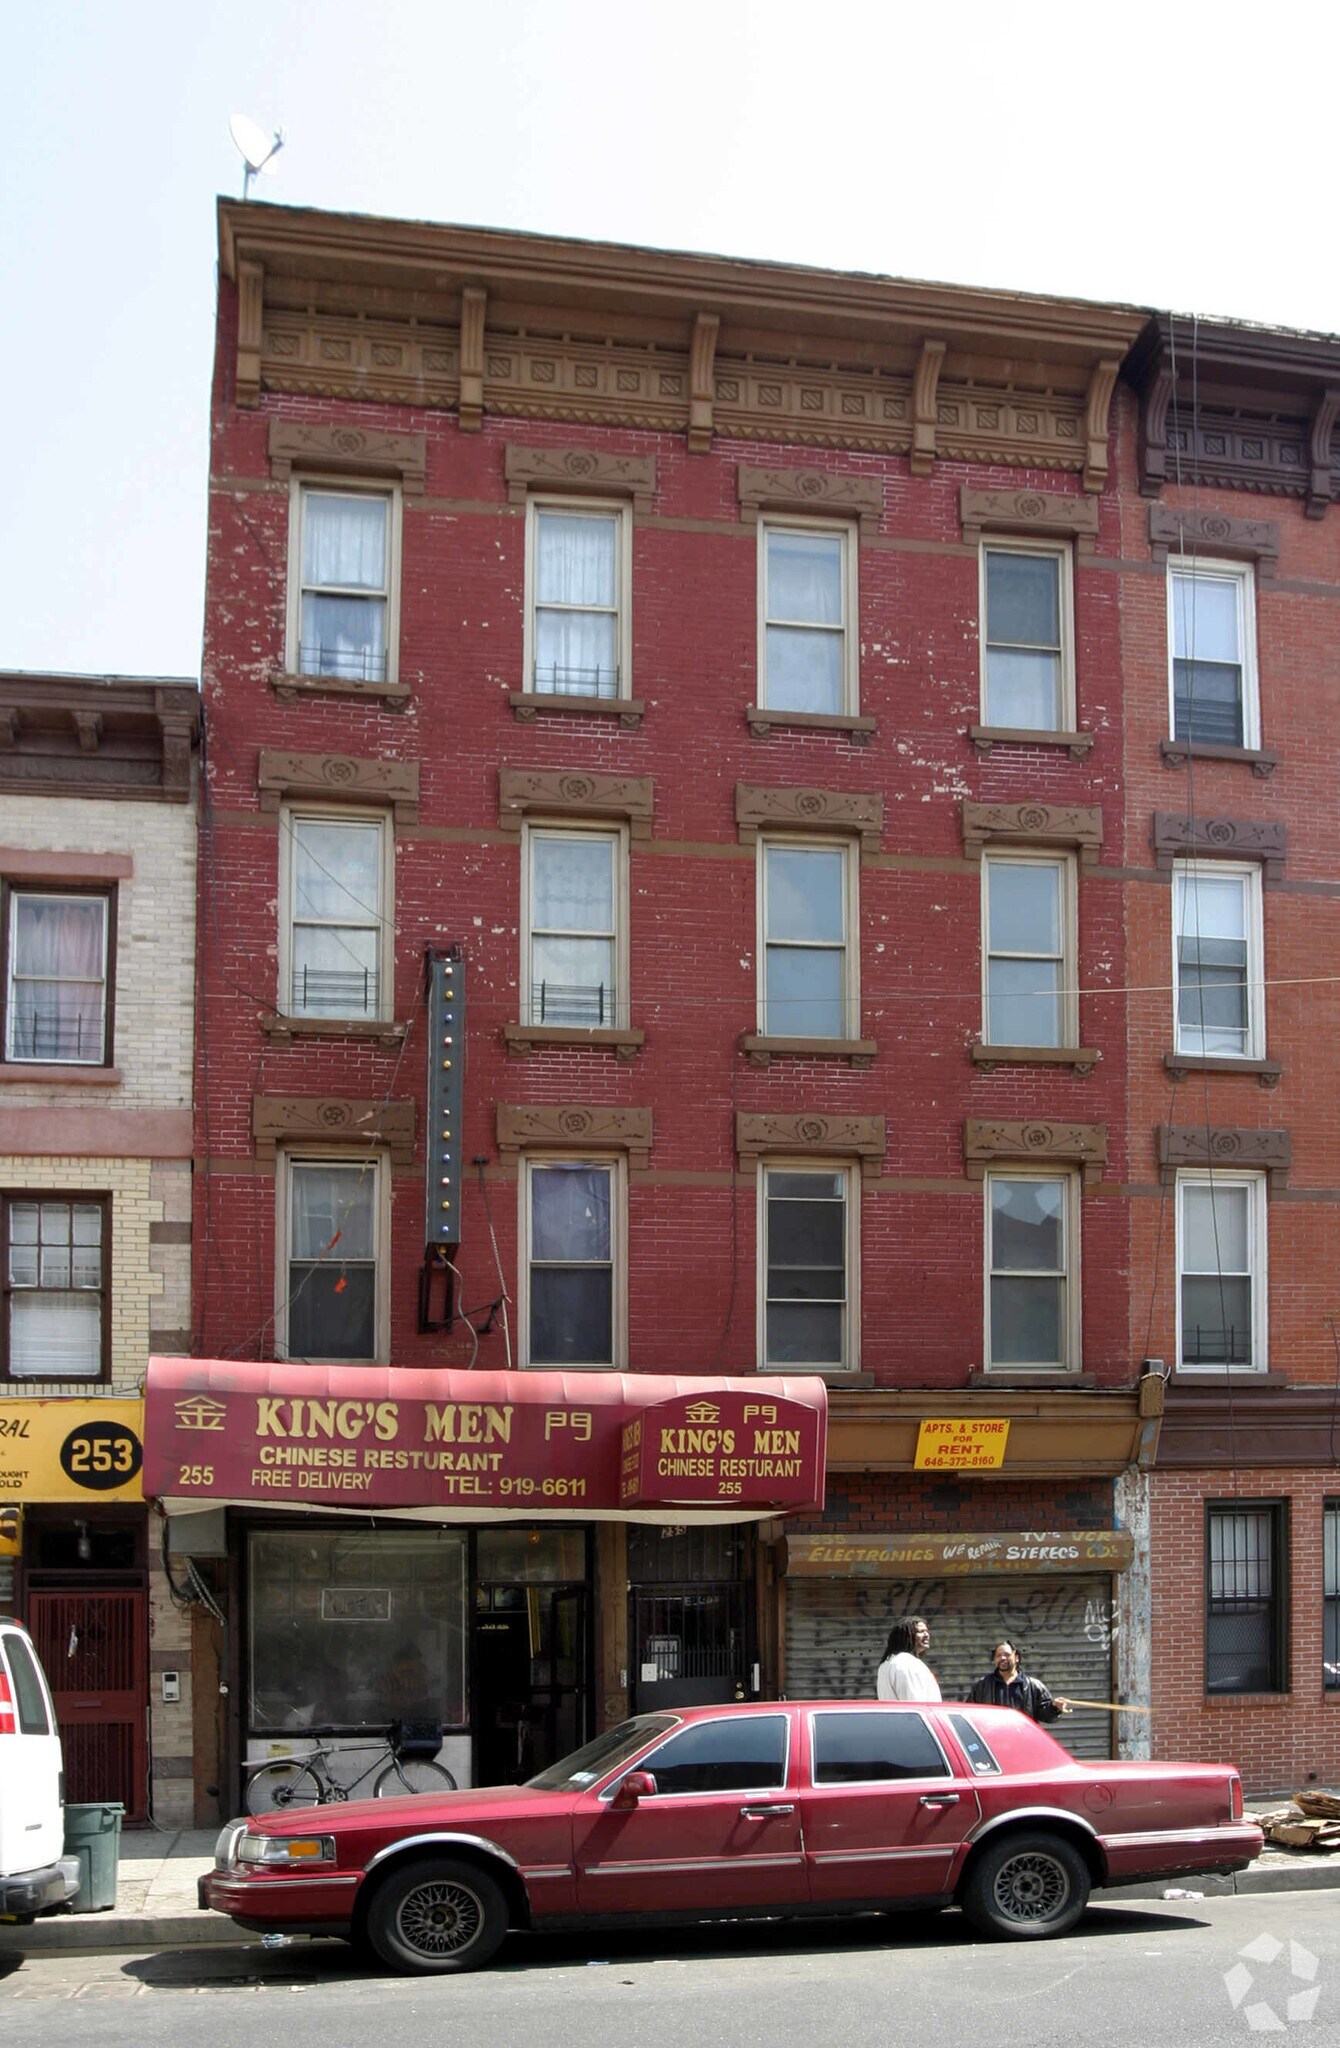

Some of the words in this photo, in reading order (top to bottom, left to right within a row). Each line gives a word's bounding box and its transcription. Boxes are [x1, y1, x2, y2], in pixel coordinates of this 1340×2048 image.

[174, 1395, 227, 1431] 金
[545, 1411, 592, 1441] 門
[255, 1397, 399, 1441] KING'S
[423, 1403, 514, 1444] MEN
[685, 1401, 720, 1424] 金
[743, 1405, 777, 1425] 門
[953, 1435, 973, 1443] FOR
[959, 1424, 966, 1434] &
[971, 1423, 1005, 1434] STORE
[660, 1429, 735, 1454] KING'S
[753, 1430, 801, 1455] MEN
[938, 1445, 984, 1455] RENT
[71, 1439, 133, 1472] 253
[259, 1446, 357, 1468] CHINESE
[364, 1450, 503, 1471] RESTURANT
[179, 1465, 214, 1486] 255
[658, 1458, 715, 1477] CHINESE
[719, 1459, 802, 1478] RESTURANT
[251, 1469, 292, 1488] FREE
[298, 1471, 373, 1490] DELIVERY
[444, 1475, 493, 1495] TEL:
[499, 1477, 586, 1497] 919-6611
[718, 1482, 742, 1494] 255
[808, 1547, 934, 1562] ELECTRONICS
[943, 1544, 967, 1560] WE
[967, 1541, 1001, 1560] REPAIR
